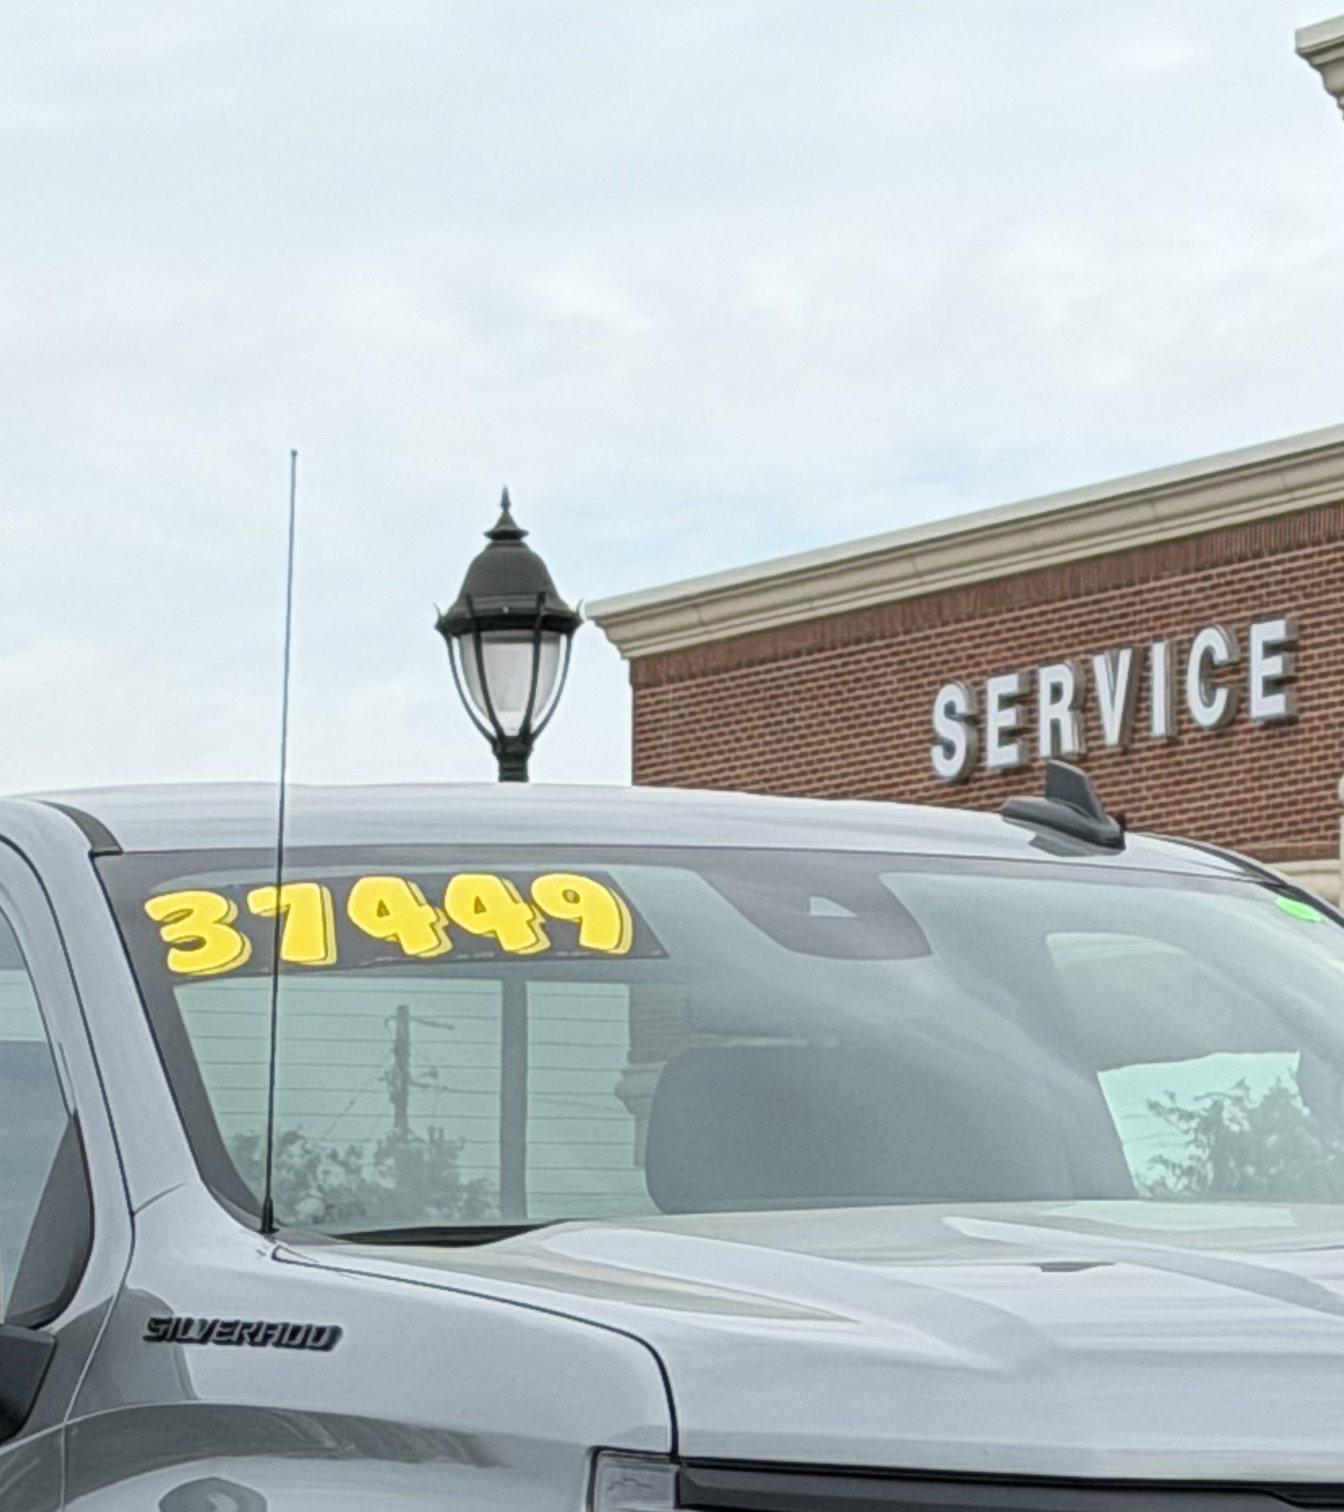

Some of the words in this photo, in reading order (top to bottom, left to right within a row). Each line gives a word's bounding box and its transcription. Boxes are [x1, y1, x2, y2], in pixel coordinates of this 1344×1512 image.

[931, 615, 1295, 783] SERVICE
[144, 872, 633, 976] 37449
[142, 1316, 344, 1353] SILVERADO
